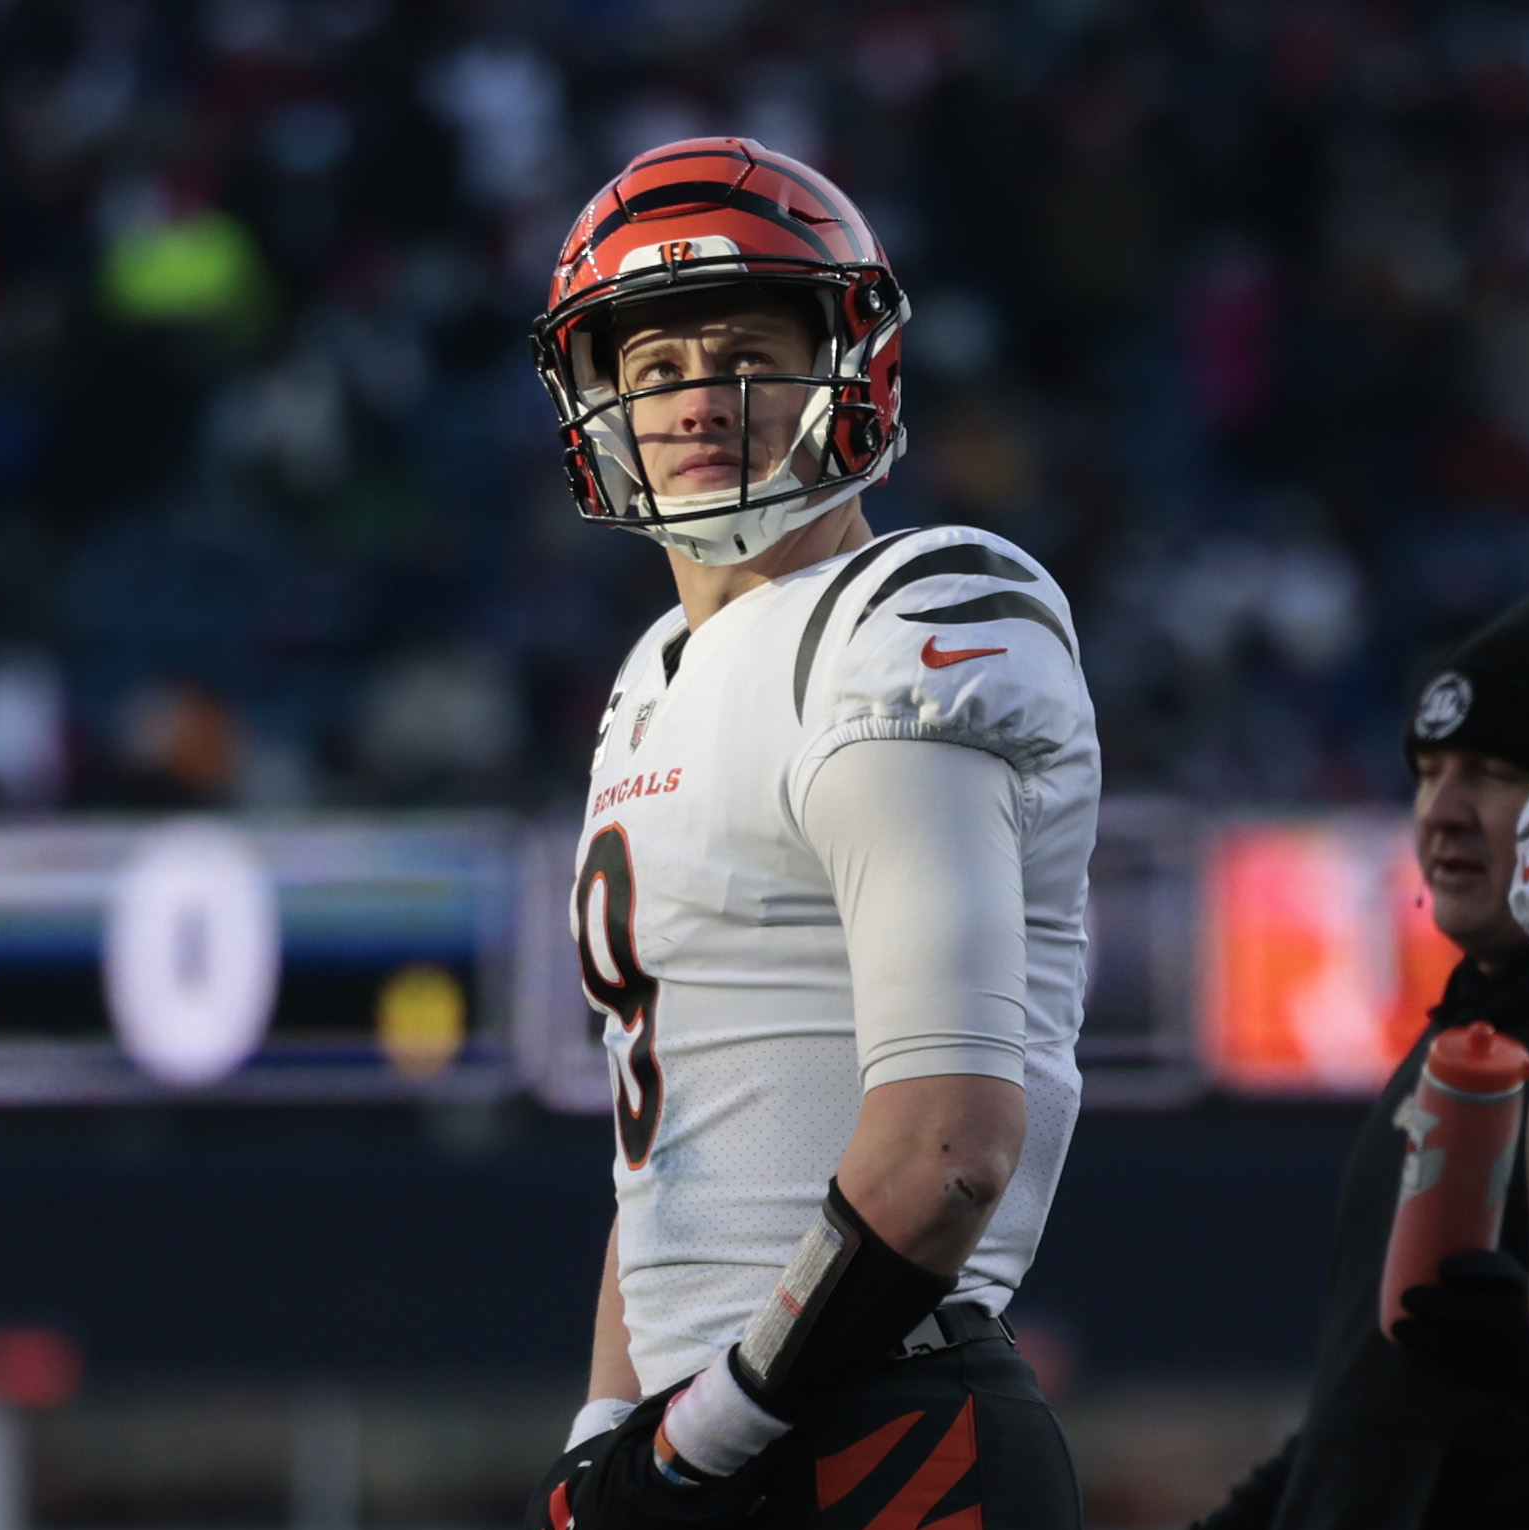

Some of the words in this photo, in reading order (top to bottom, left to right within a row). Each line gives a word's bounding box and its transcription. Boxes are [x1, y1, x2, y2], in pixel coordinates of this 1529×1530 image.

[591, 767, 683, 818] BENGALS
[106, 822, 278, 1084] 0
[576, 821, 664, 1170] 9
